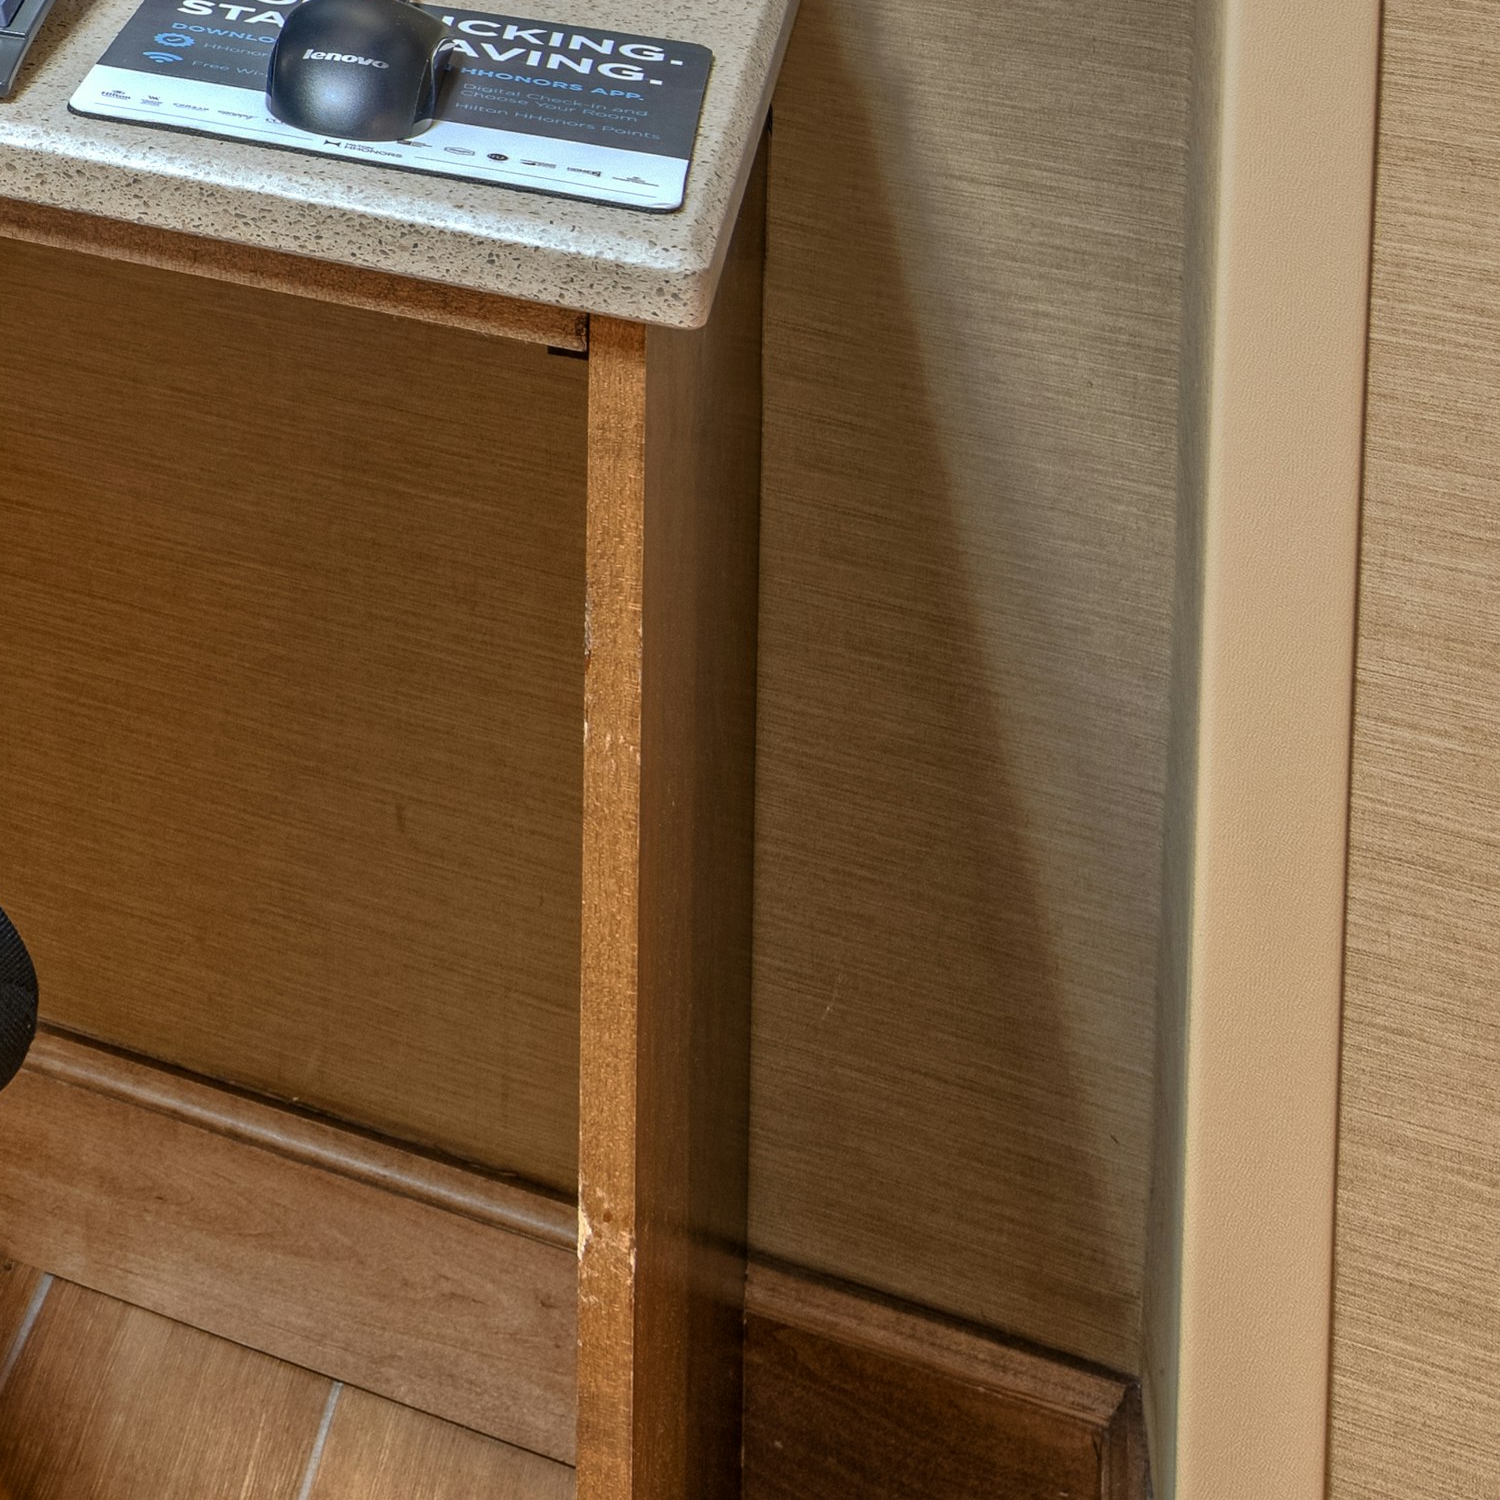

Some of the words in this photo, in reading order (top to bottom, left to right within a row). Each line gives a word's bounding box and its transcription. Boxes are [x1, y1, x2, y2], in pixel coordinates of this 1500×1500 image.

[172, 23, 275, 43] DOWNLO
[461, 68, 583, 91] HHONORS
[590, 88, 644, 100] APP.
[177, 0, 285, 27] STA
[453, 39, 663, 85] AVING.
[204, 43, 269, 56] HHonor
[464, 83, 520, 97] Digital
[527, 93, 607, 110] Check-in
[613, 108, 648, 116] and
[302, 49, 389, 69] lenovo
[192, 61, 229, 71] Free
[237, 67, 268, 77] Wi-
[456, 102, 507, 115] Hilton
[515, 112, 595, 130] HHonors
[602, 126, 660, 139] Points
[461, 90, 528, 105] Choose
[536, 102, 576, 112] Your
[583, 109, 637, 122] Room
